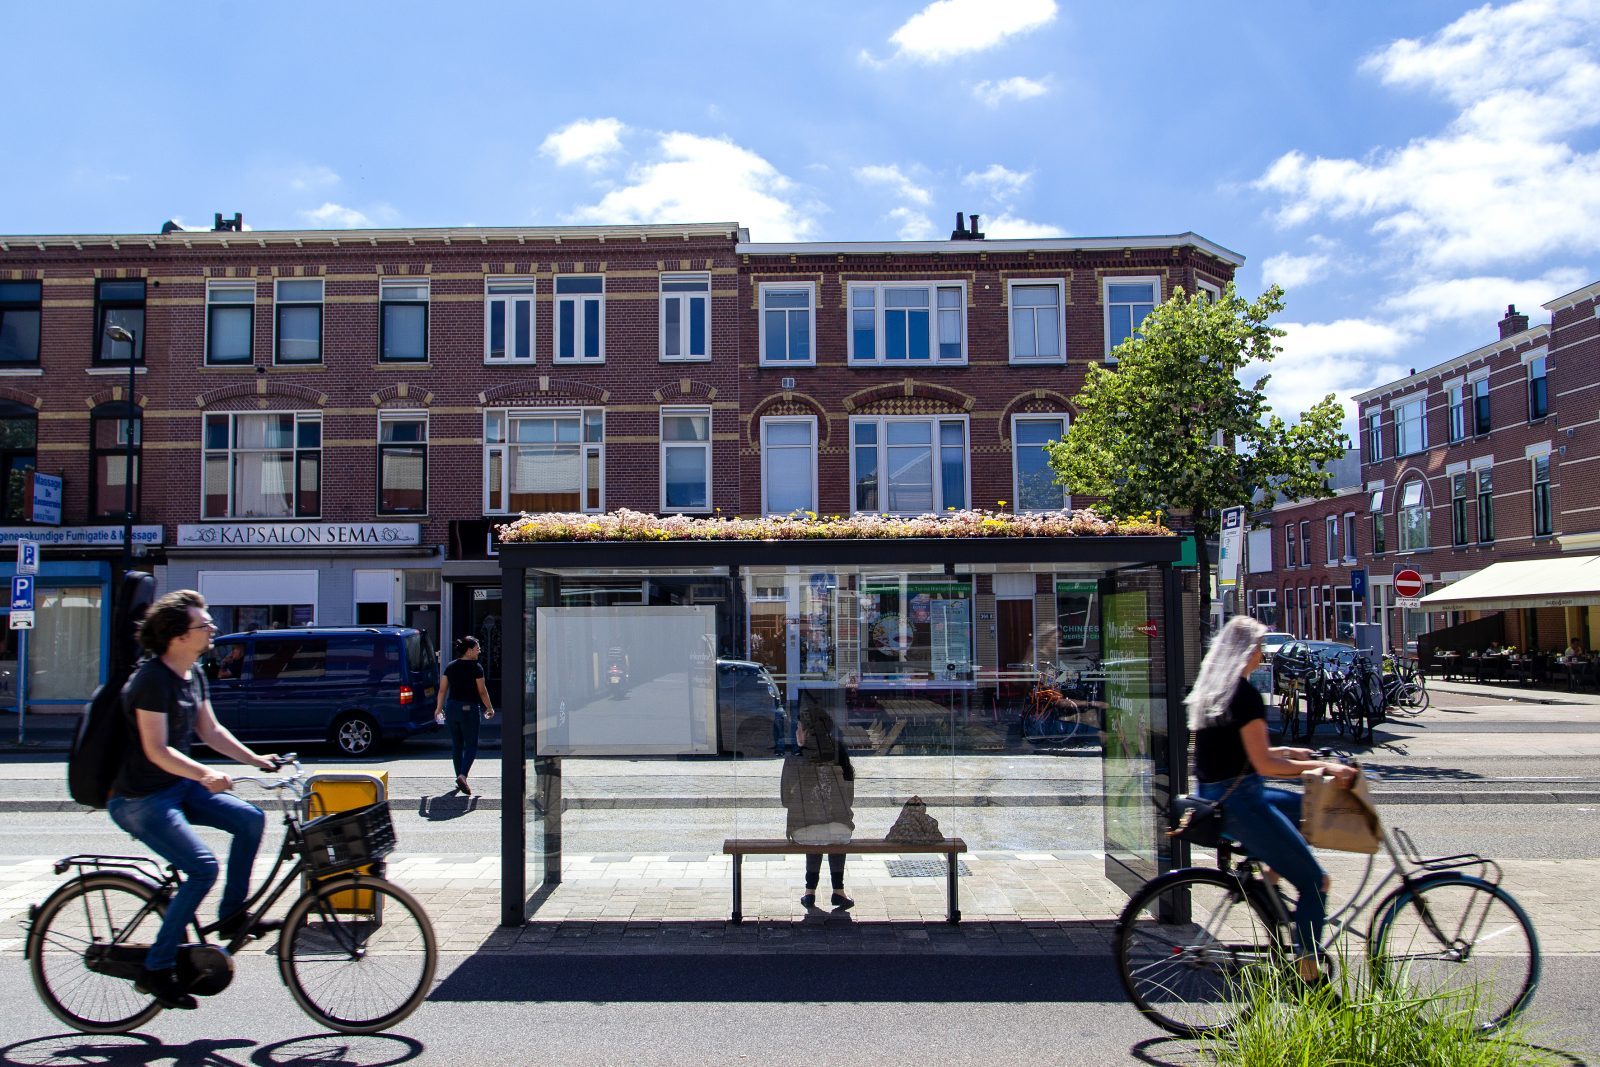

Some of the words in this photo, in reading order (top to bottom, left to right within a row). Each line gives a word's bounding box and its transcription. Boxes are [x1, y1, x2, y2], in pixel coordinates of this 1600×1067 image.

[66, 530, 109, 543] Fumigatie
[110, 530, 117, 540] &
[119, 530, 158, 542] Mssage
[220, 526, 322, 543] KAPSALON
[326, 526, 381, 543] SEMA
[16, 578, 29, 596] P
[1354, 577, 1361, 589] P
